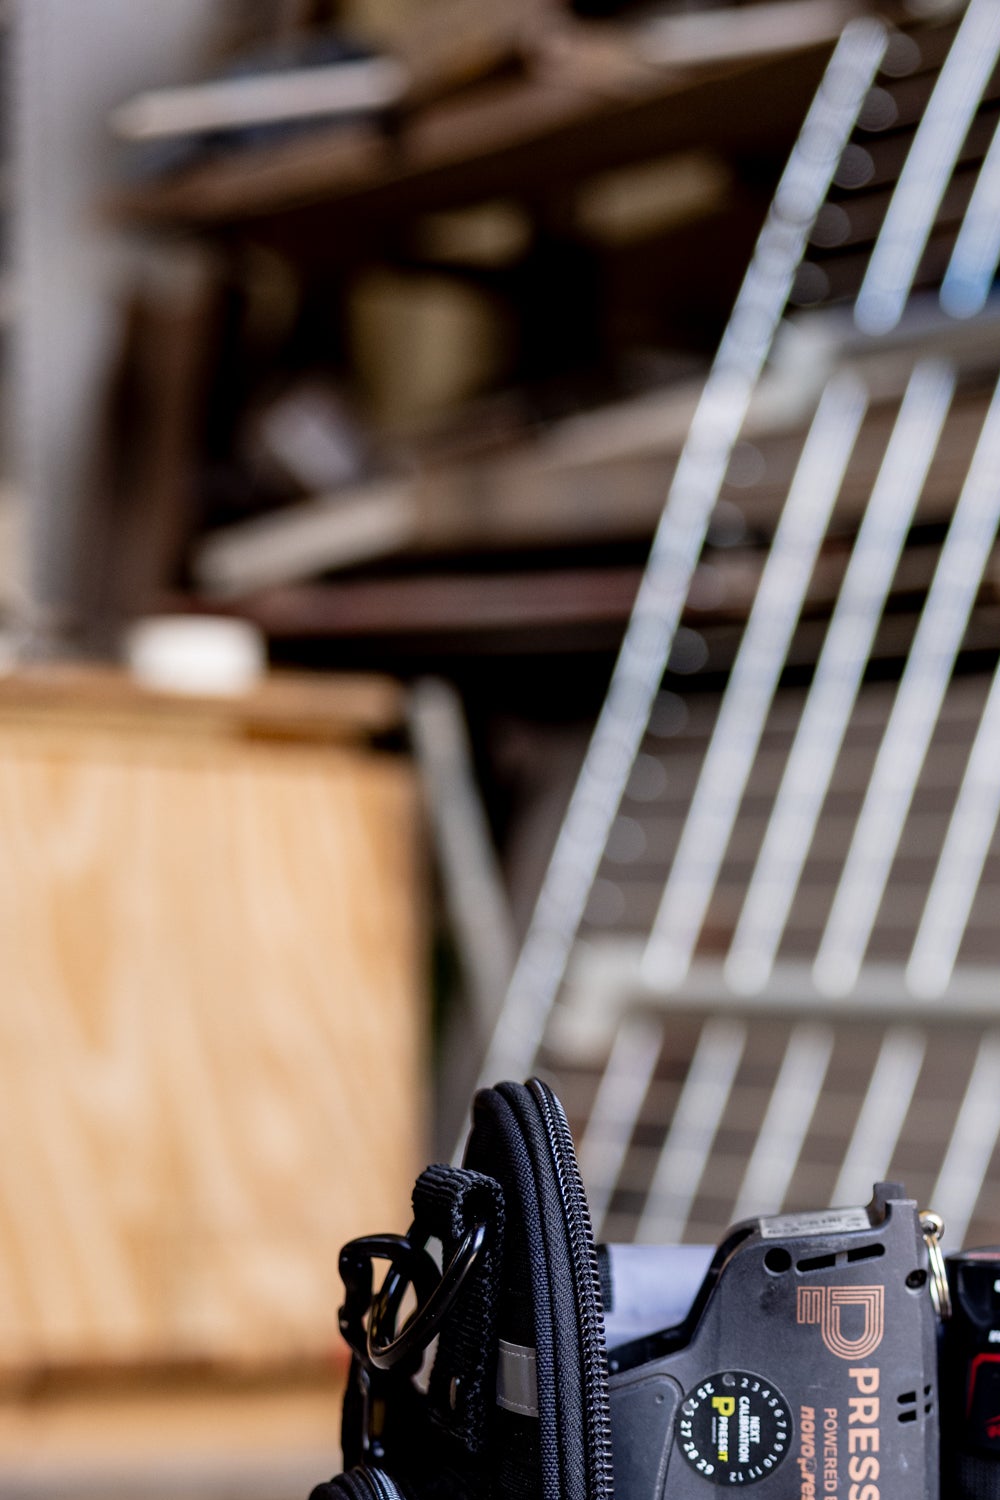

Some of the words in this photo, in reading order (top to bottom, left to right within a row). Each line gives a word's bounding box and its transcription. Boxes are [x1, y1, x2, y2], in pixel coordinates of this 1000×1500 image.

[740, 1378, 749, 1388] 2
[751, 1382, 760, 1392] 3
[697, 1382, 715, 1400] 25
[761, 1390, 770, 1399] 4
[768, 1398, 778, 1407] 5
[774, 1409, 784, 1417] 6
[680, 1419, 693, 1438] 27
[738, 1395, 751, 1463] CALIBRATION
[749, 1415, 761, 1444] NEXT
[777, 1420, 786, 1428] 7
[717, 1415, 729, 1463] PRESSIT
[776, 1432, 786, 1440] 8
[683, 1441, 699, 1460] 28
[774, 1443, 783, 1452] 9
[823, 1407, 838, 1493] POWERED
[696, 1458, 715, 1475] 29
[763, 1453, 778, 1468] 10
[729, 1471, 744, 1482] 12
[748, 1465, 763, 1479] 11
